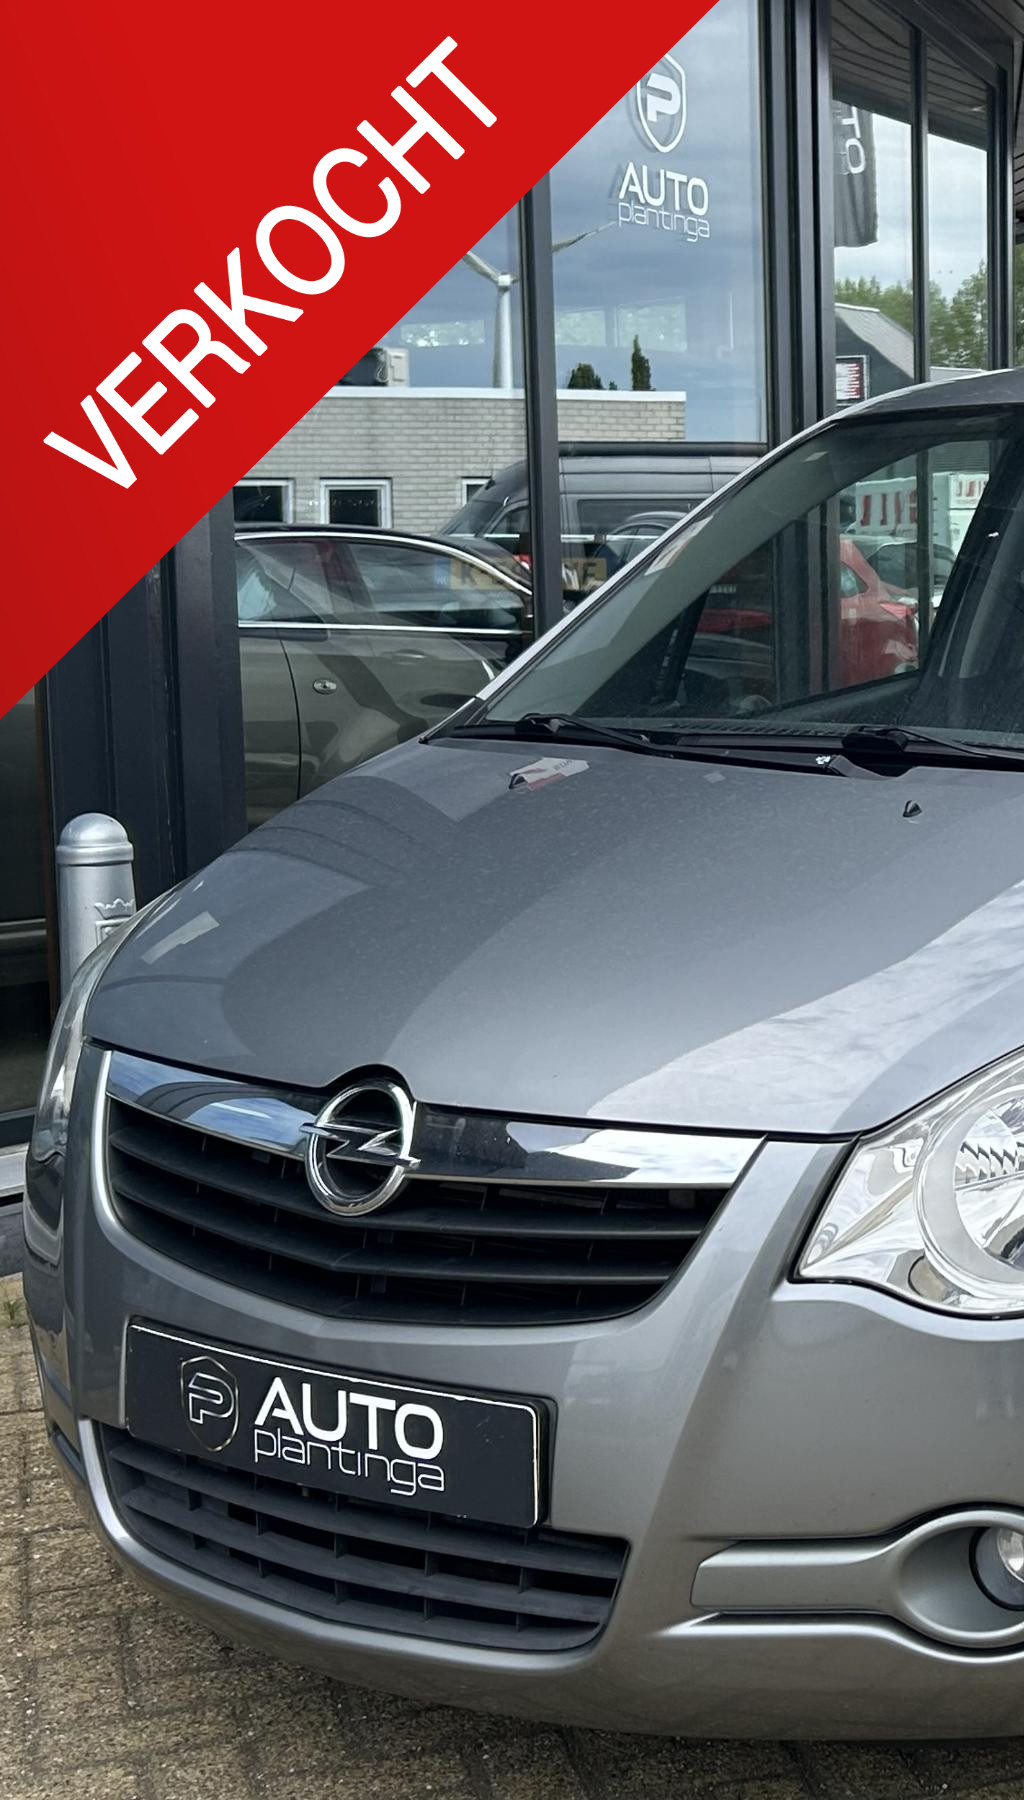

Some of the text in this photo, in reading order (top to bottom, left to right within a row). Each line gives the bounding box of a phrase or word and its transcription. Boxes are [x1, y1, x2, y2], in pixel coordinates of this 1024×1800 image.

[619, 161, 709, 216] AUTO
[618, 199, 710, 242] plantinga
[254, 1376, 444, 1460] AUTO
[254, 1427, 445, 1496] plantinga
